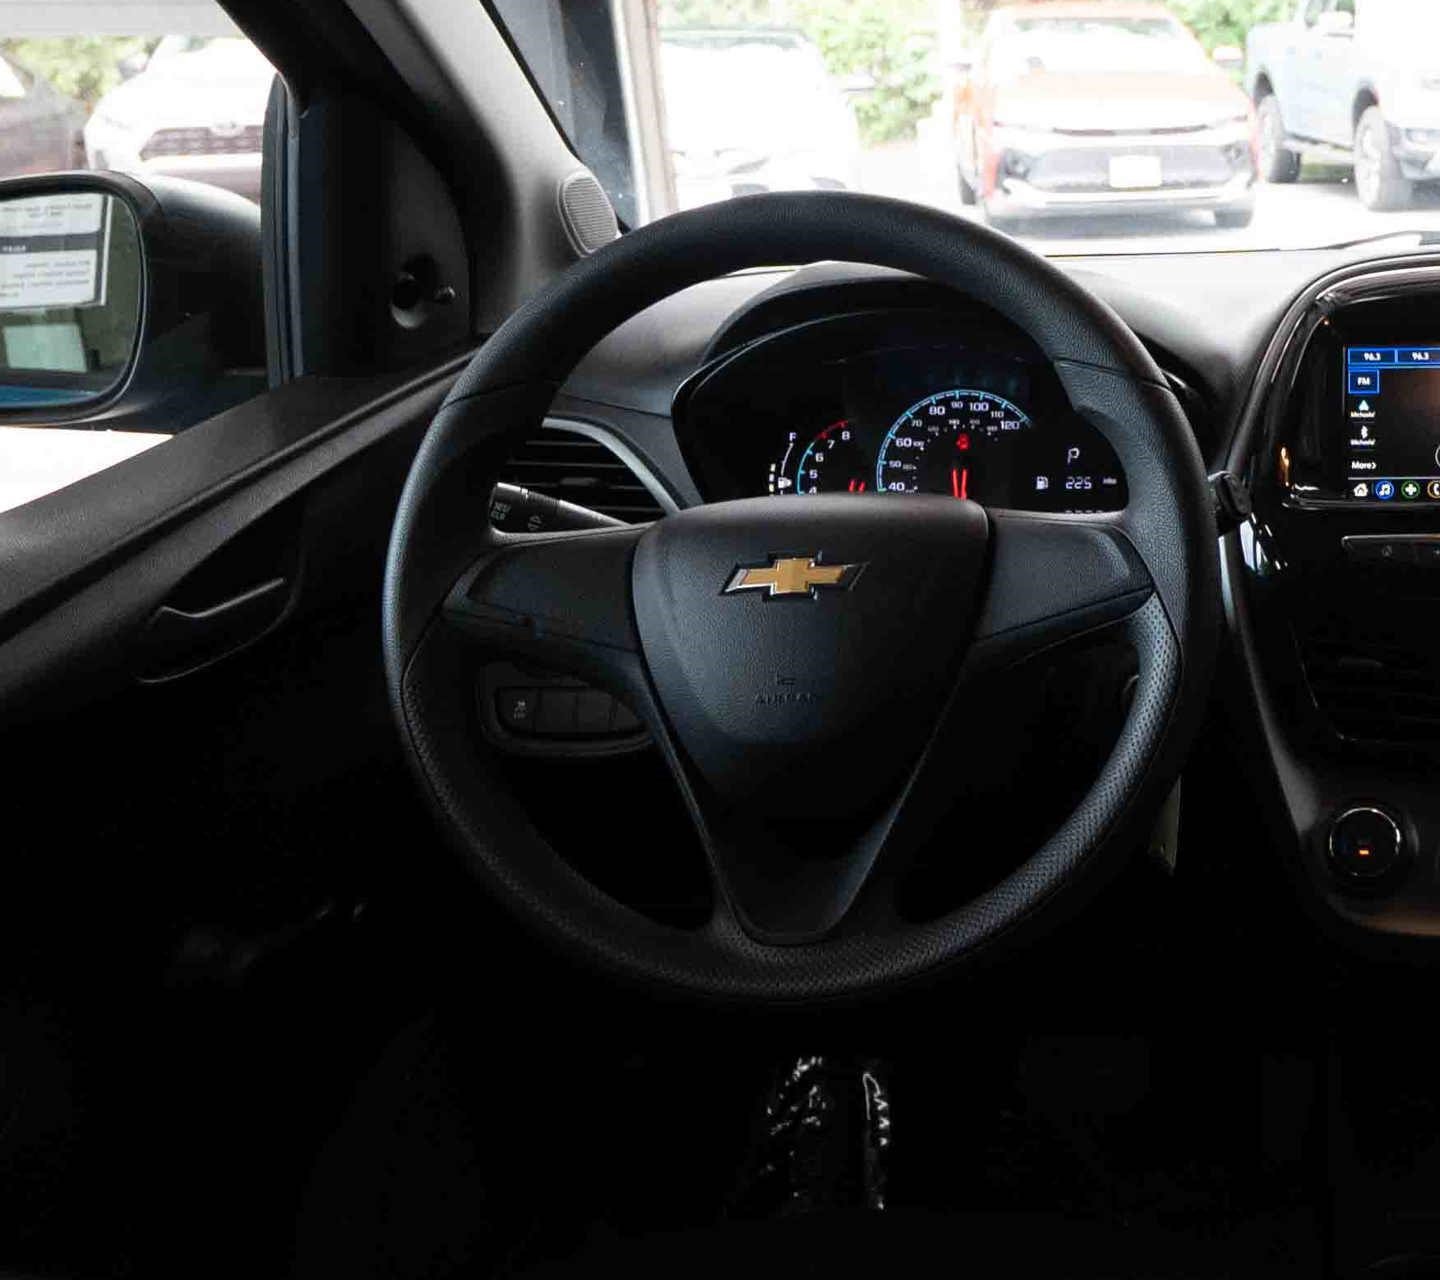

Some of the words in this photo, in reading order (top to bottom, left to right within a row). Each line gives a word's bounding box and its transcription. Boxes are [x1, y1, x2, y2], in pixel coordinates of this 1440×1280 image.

[1357, 376, 1371, 386] FM
[928, 406, 946, 416] 80
[969, 402, 989, 412] 100
[1000, 420, 1020, 430] 120
[789, 432, 797, 441] F
[841, 431, 851, 440] 8
[827, 439, 836, 449] 7
[895, 437, 912, 448] 60
[815, 452, 825, 462] 6
[1067, 447, 1080, 464] P
[1351, 460, 1372, 470] More
[809, 469, 818, 479] 5
[888, 481, 905, 492] 40
[1065, 476, 1093, 490] 225
